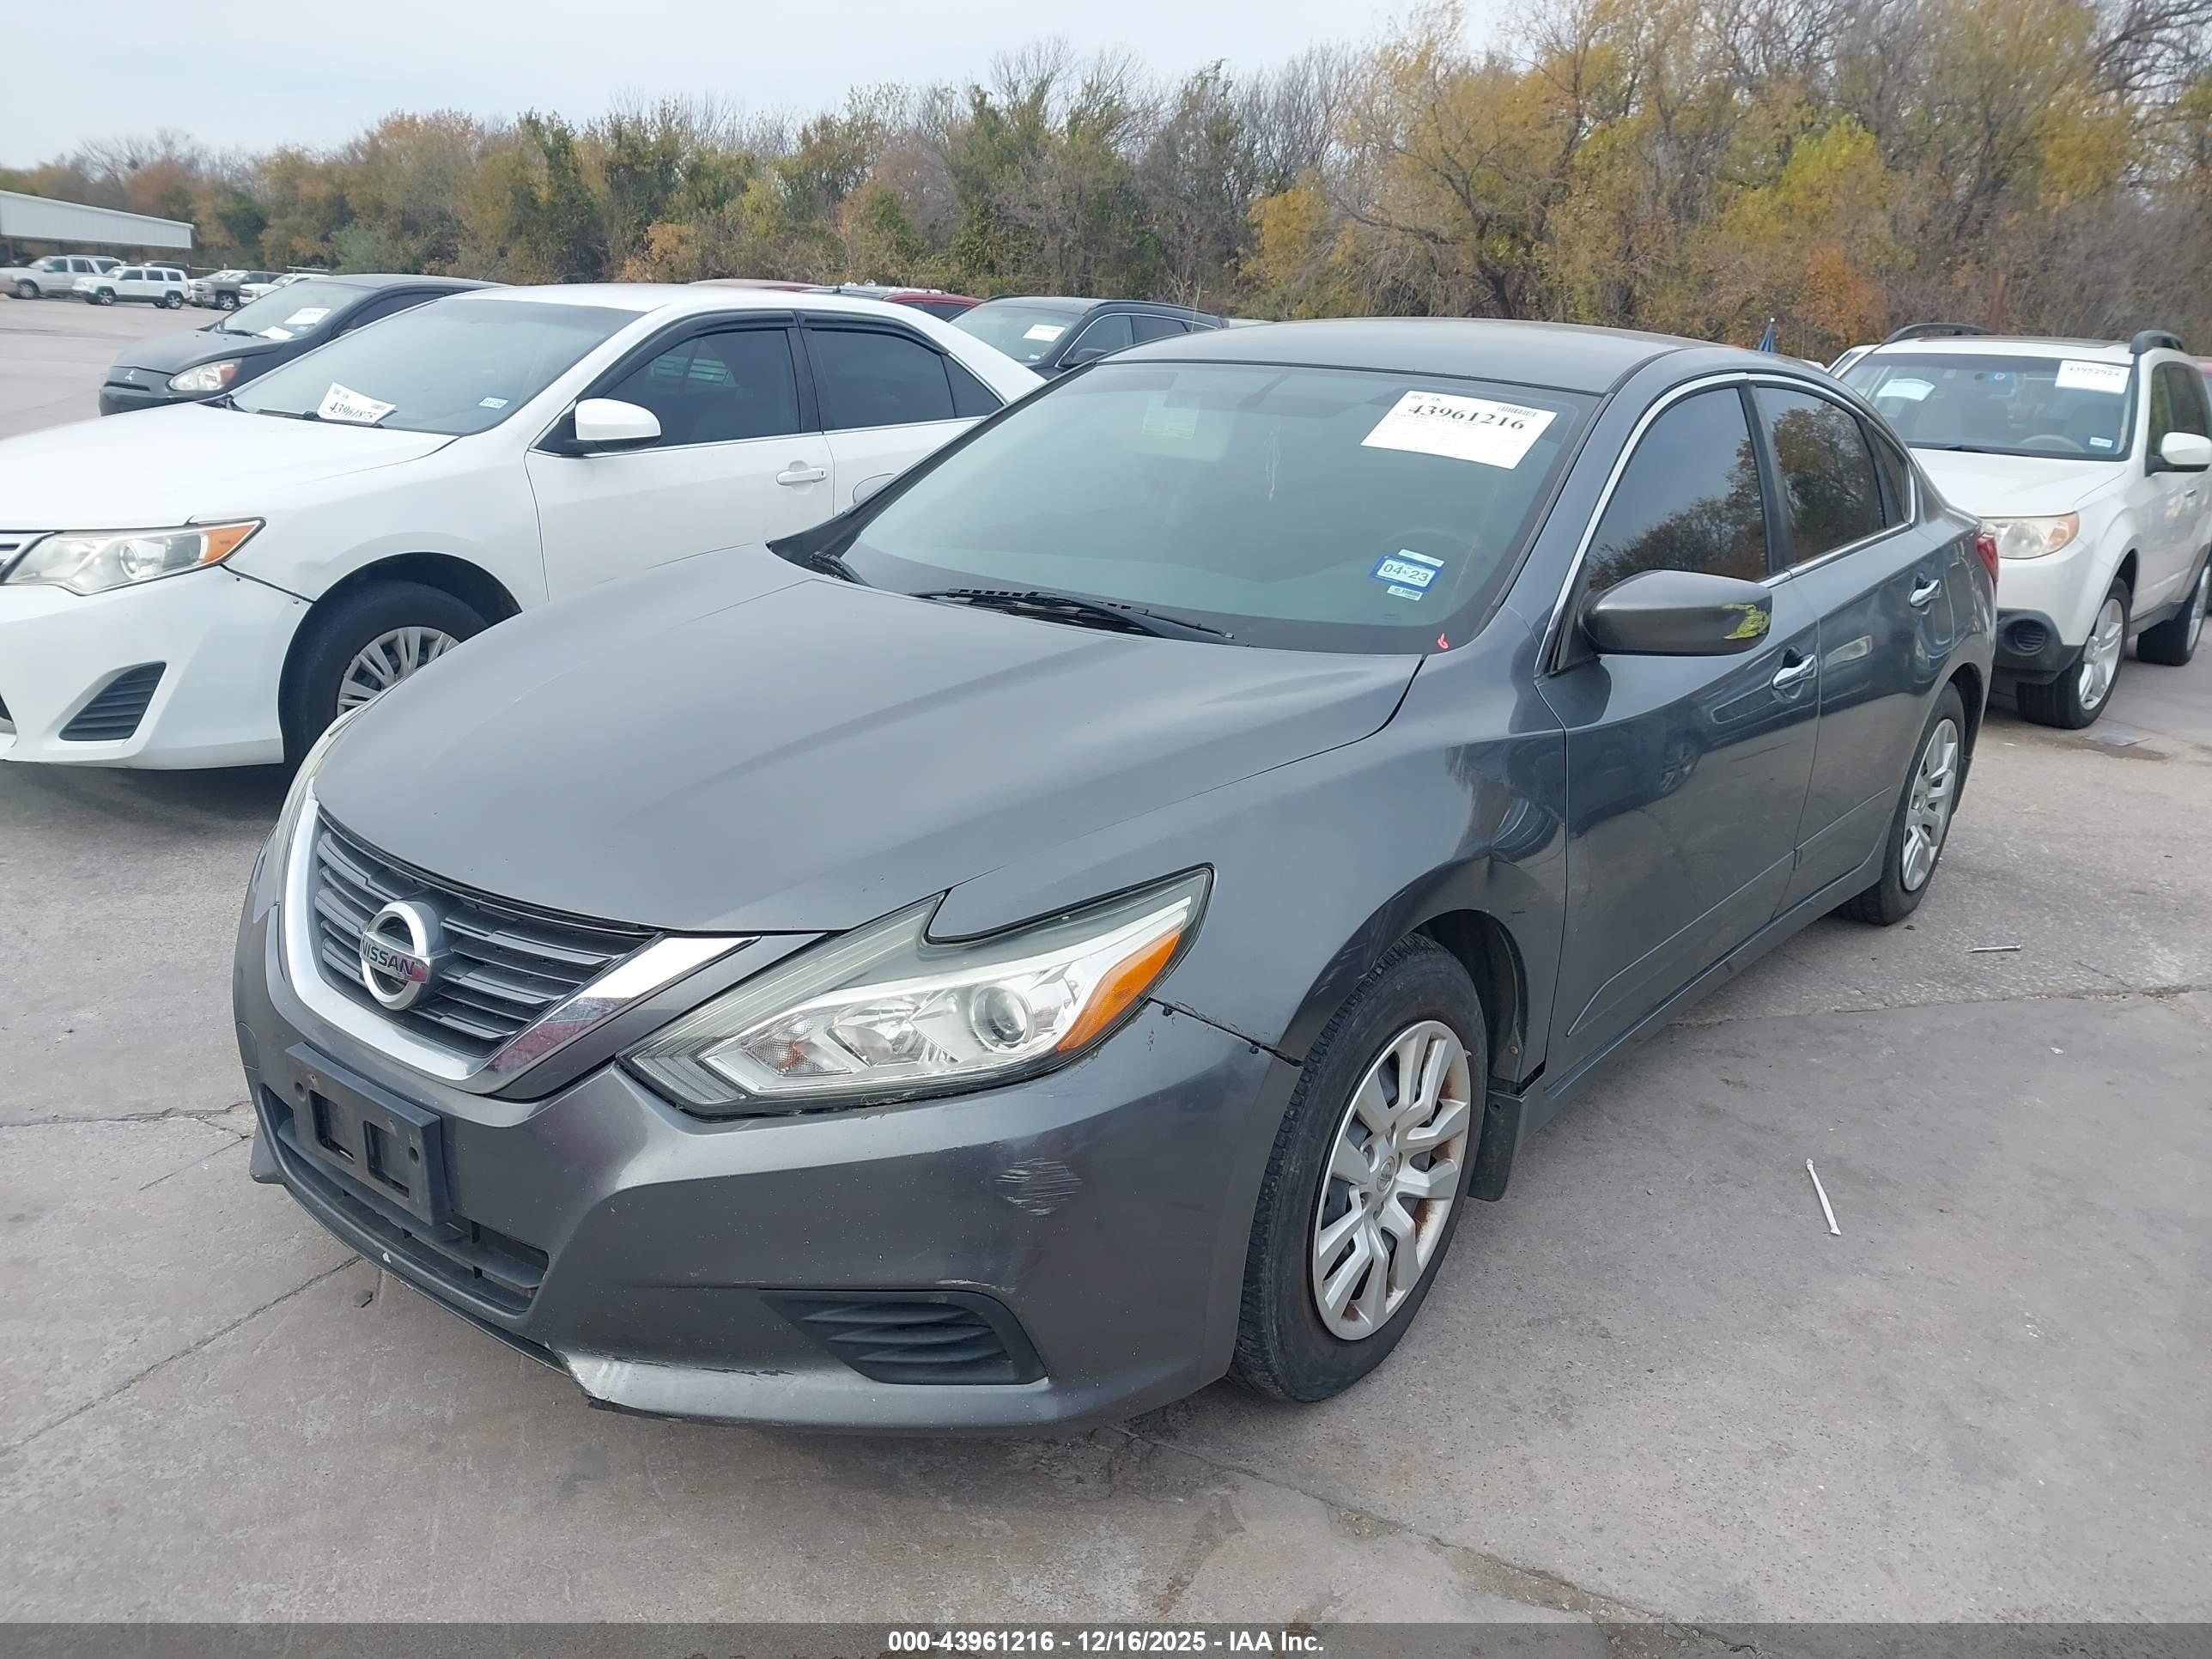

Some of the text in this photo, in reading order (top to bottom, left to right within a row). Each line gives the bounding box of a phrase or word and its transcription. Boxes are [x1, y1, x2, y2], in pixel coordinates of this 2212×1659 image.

[1407, 404, 1525, 430] 43961216
[1382, 563, 1430, 582] 04 23
[361, 939, 415, 976] NISSAN
